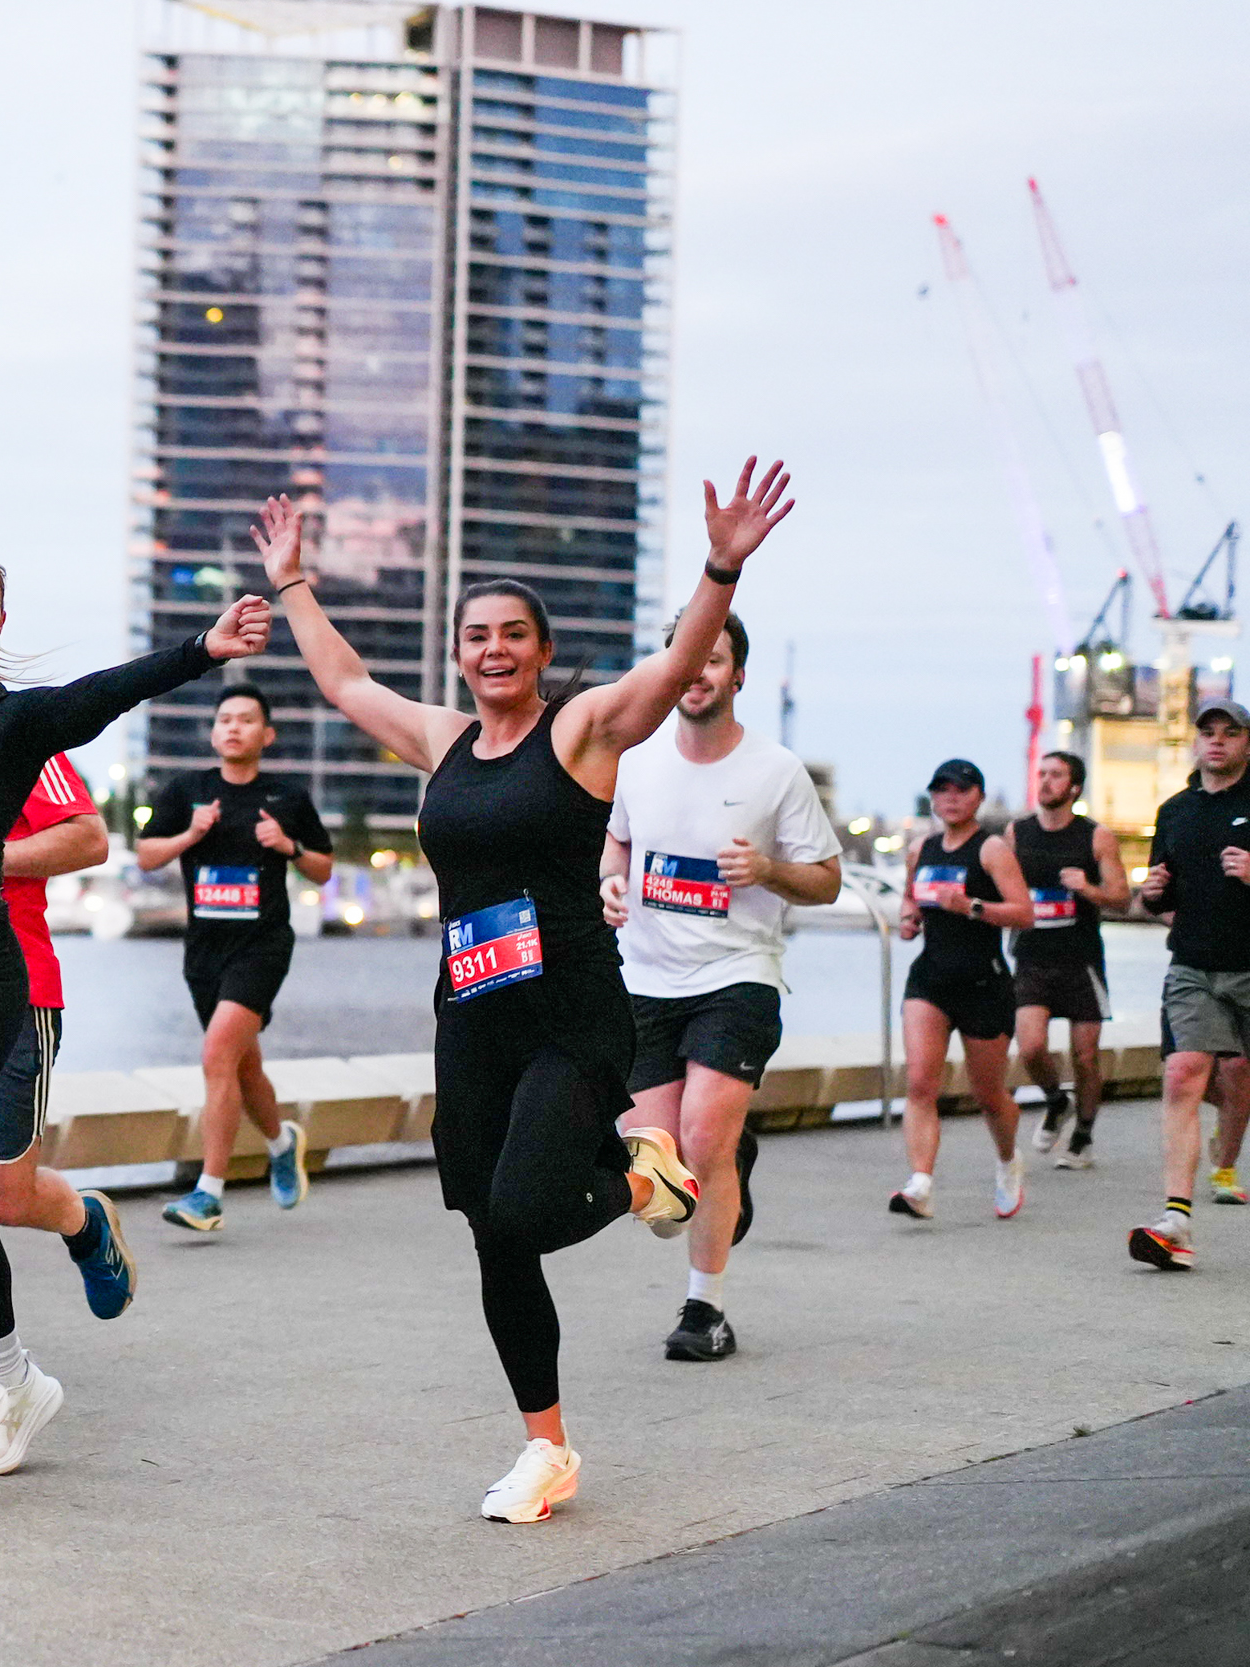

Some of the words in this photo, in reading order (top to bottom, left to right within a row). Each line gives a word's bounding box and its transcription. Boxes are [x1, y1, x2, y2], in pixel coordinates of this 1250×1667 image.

[645, 885, 703, 906] THOMAS
[449, 922, 474, 951] RM
[516, 938, 538, 951] 21.1K
[452, 947, 497, 983] 9311
